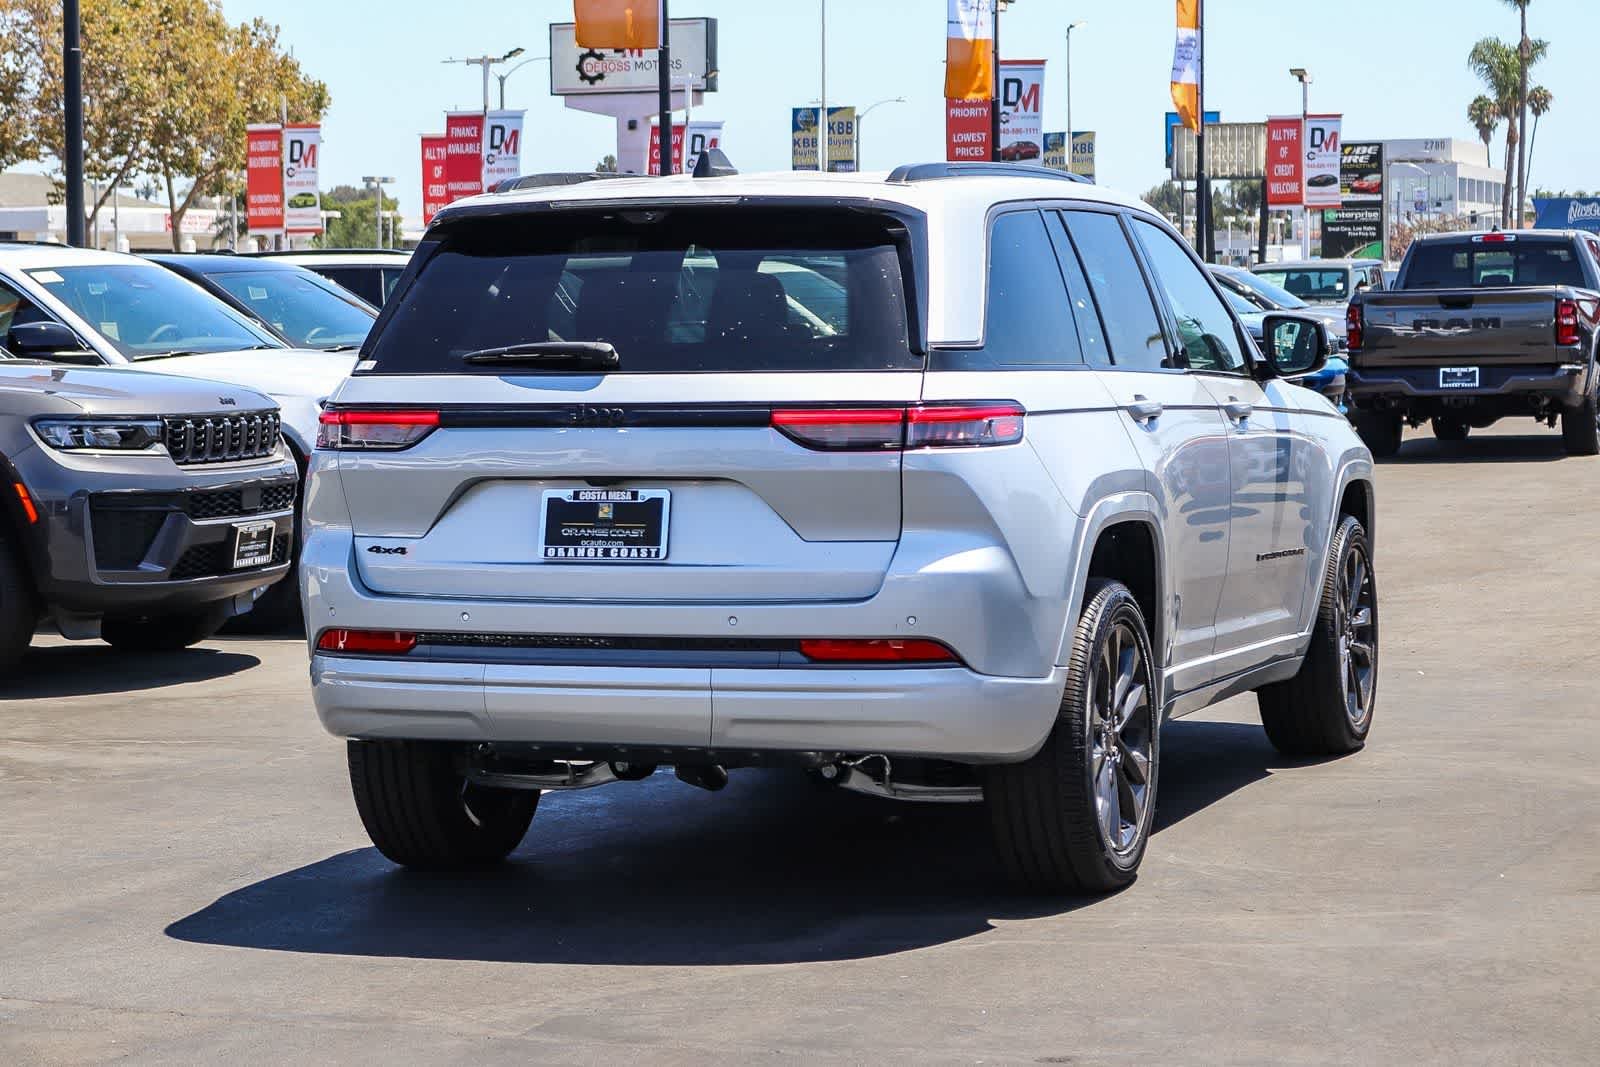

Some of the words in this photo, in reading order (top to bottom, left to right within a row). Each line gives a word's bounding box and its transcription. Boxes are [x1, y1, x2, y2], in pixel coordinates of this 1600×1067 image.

[585, 61, 631, 72] DEBOSS
[634, 58, 682, 71] MOTRS
[950, 107, 989, 118] PRIORITY
[450, 126, 479, 137] FINANCE
[828, 121, 853, 135] KBB
[953, 132, 987, 143] LOWEST
[1283, 129, 1297, 141] TYPE
[793, 137, 818, 148] KBB
[1072, 143, 1094, 153] KBB
[447, 143, 481, 154] AVAILABLE
[955, 147, 985, 157] PRICES
[1280, 146, 1289, 159] OF
[1043, 156, 1065, 168] KBB
[434, 166, 443, 178] OF
[1274, 164, 1295, 177] CREDIT
[1271, 182, 1300, 195] WELCOME
[1327, 211, 1379, 220] enterprise
[1413, 316, 1502, 331] RAM
[580, 491, 607, 500] COSTA
[609, 491, 632, 500] MESA
[561, 528, 608, 537] ORANGE
[610, 528, 645, 537] COAST
[367, 545, 408, 555] 4x4
[547, 548, 604, 557] ORANGE
[611, 548, 657, 558] COAST
